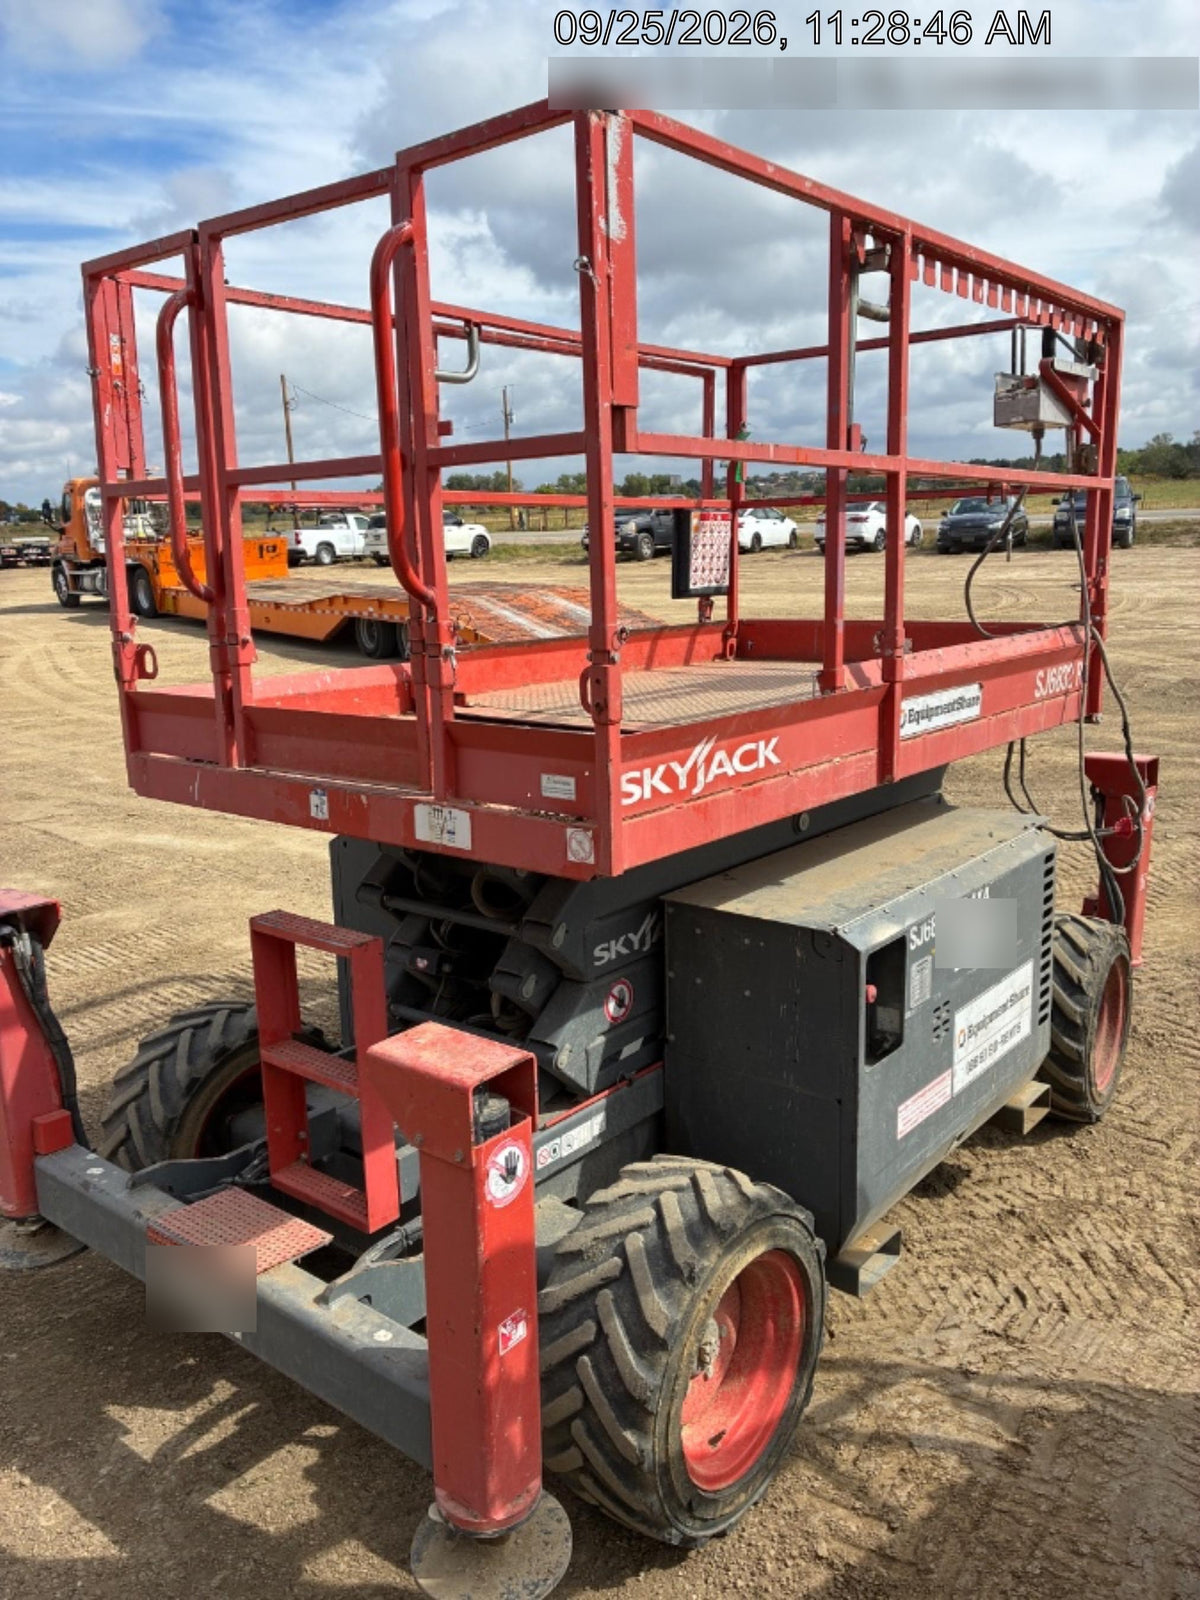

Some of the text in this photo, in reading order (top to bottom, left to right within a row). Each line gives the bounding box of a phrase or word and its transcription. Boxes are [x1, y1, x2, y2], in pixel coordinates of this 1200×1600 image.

[908, 695, 980, 724] EquipmentShare
[620, 735, 781, 805] SKYJACK
[593, 911, 659, 966] SKYJ
